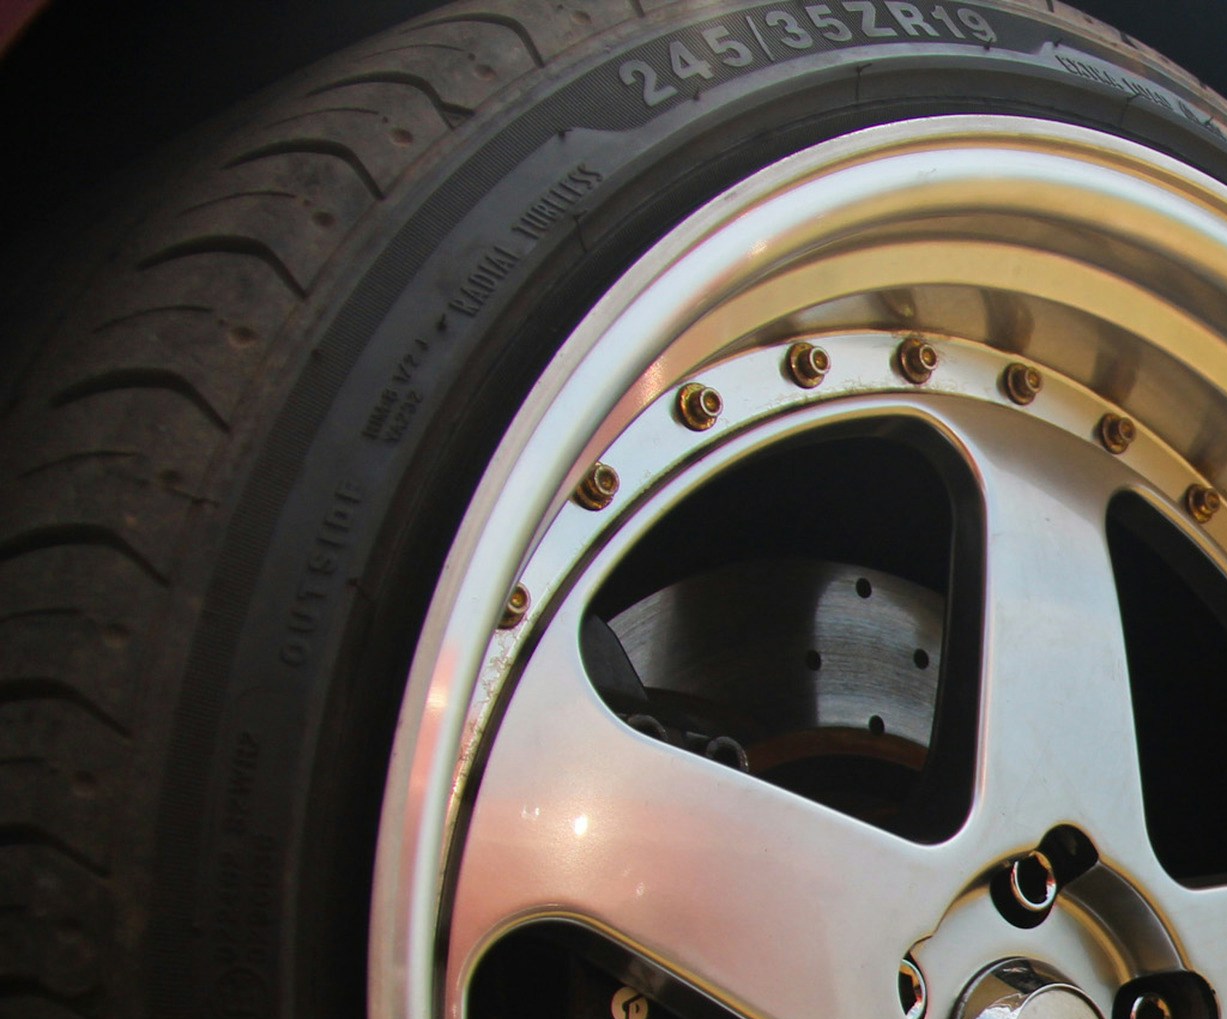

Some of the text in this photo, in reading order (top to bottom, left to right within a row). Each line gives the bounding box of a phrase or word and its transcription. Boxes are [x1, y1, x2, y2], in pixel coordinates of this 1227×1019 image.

[618, 0, 997, 106] 245/35ZR19
[448, 163, 603, 318] RADIAL TUBELESS
[280, 477, 365, 668] OUTSIDE
